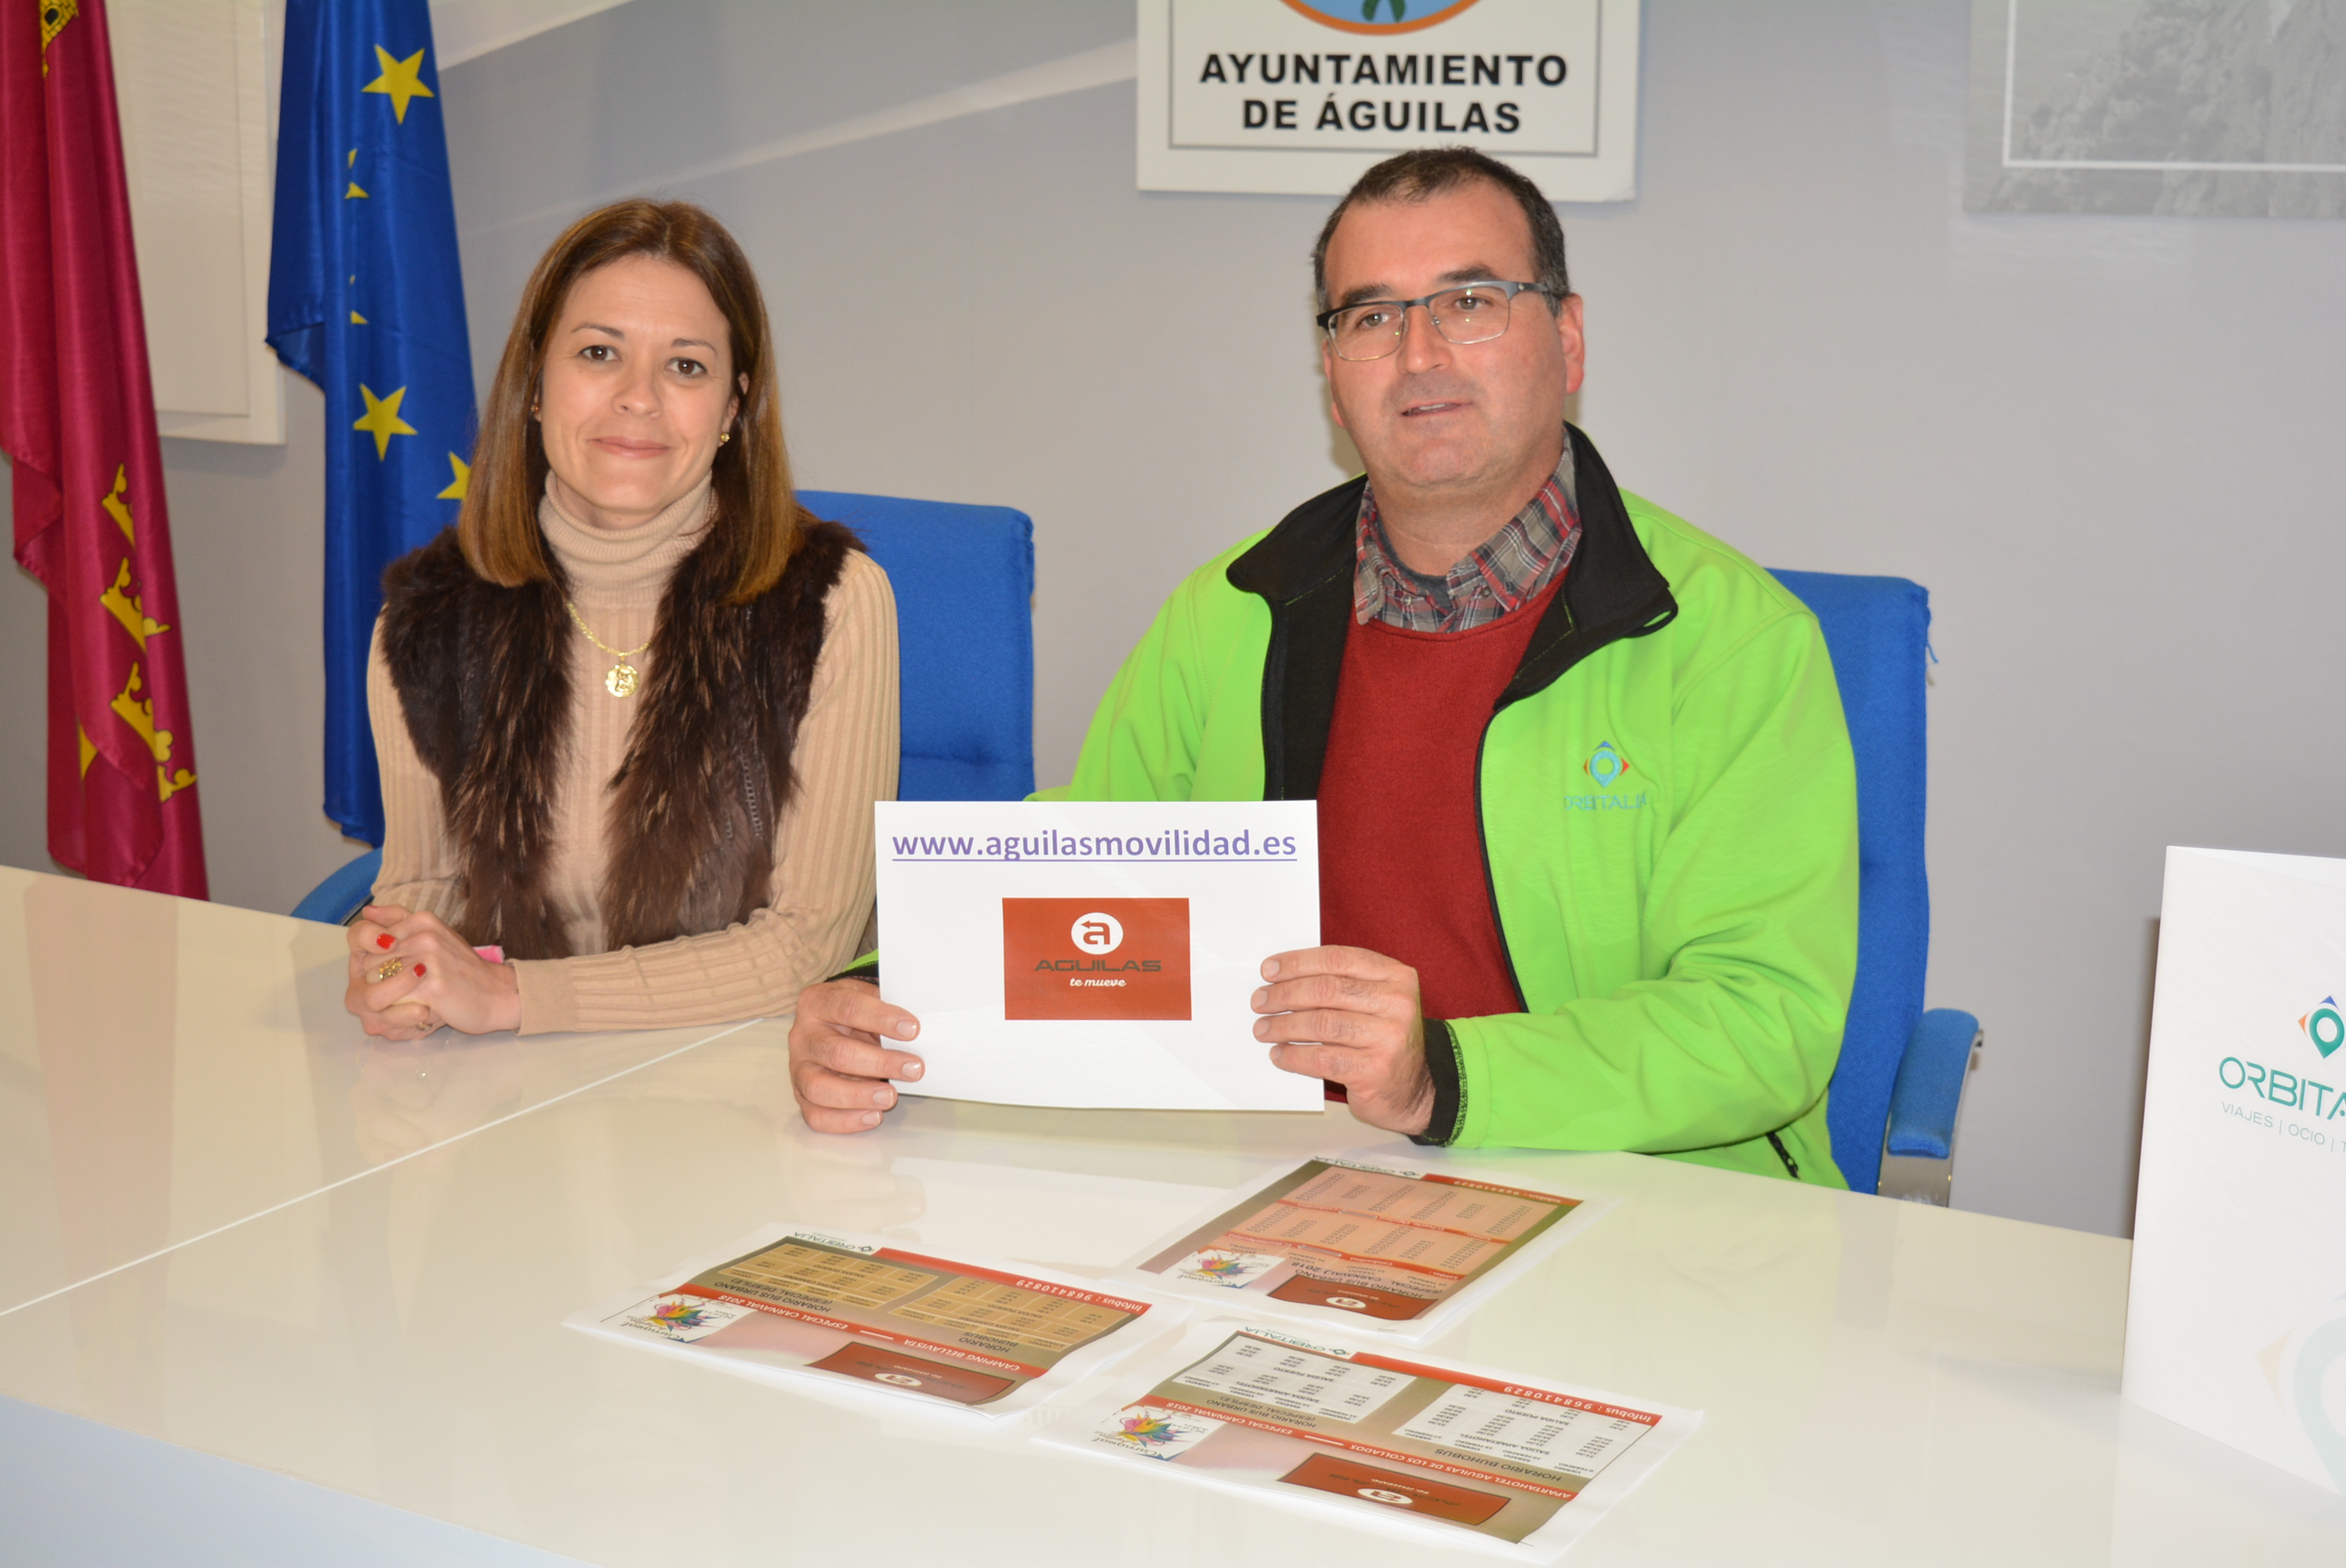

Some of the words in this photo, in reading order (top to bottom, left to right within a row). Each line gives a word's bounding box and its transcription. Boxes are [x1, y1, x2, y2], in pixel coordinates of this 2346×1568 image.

[1200, 53, 1568, 87] AYUNTAMIENTO
[1243, 100, 1298, 130] DE
[1316, 92, 1520, 133] ÁGUILAS
[892, 829, 1297, 862] www.aguilasmovilidad.es
[1034, 960, 1161, 972] AGUILAS
[1070, 977, 1084, 987] te
[1084, 978, 1127, 987] mueve
[2222, 1101, 2273, 1127] VIAJES
[2289, 1123, 2325, 1145] OCIO
[794, 1232, 855, 1249] ORBITALIA
[1291, 1262, 1321, 1272] 2018
[1295, 1269, 1342, 1283] URBANO
[1324, 1270, 1381, 1281] CARNAVAL)
[714, 1283, 758, 1295] URBANO
[731, 1279, 777, 1292] DESFILE)
[1016, 1280, 1092, 1301] 968410829
[1371, 1284, 1422, 1298] HORARIO
[1392, 1281, 1442, 1294] (ESPECIAL
[719, 1295, 745, 1304] 2018
[779, 1290, 833, 1304] (ESPECIAL
[746, 1301, 799, 1317] CARNAVAL
[783, 1298, 831, 1312] HORARIO
[1103, 1298, 1142, 1311] Infobus
[801, 1315, 848, 1329] ESPECIAL
[959, 1338, 1011, 1352] HORARIO
[964, 1332, 1019, 1347] BUHOBUS
[1245, 1327, 1325, 1351] ORBITALIA
[904, 1339, 965, 1357] BELLAVISTA
[966, 1355, 1019, 1370] CAMPING
[1273, 1367, 1305, 1376] PUERTO
[1237, 1381, 1289, 1396] APARTAHOTEL
[1220, 1396, 1262, 1410] DESFILE)
[1292, 1394, 1318, 1403] SALIDA
[1504, 1386, 1592, 1410] 968410829
[1167, 1403, 1192, 1411] 2018
[1207, 1400, 1247, 1412] URBANO
[1191, 1406, 1247, 1425] CARNAVAL
[1267, 1407, 1315, 1421] (ESPECIAL
[1505, 1410, 1538, 1419] PUERTO
[1541, 1417, 1568, 1425] SALIDA
[1607, 1408, 1651, 1422] Infobus
[1248, 1421, 1292, 1435] ESPECIAL
[1271, 1415, 1316, 1428] HORARIO
[1461, 1434, 1518, 1447] APARTAHOTEL
[1350, 1445, 1405, 1460] COLLADOS
[1520, 1446, 1549, 1455] SALIDA
[1435, 1449, 1498, 1467] BUHOBUS
[1445, 1467, 1492, 1480] AGUILAS
[1501, 1465, 1562, 1481] HORARIO
[1495, 1477, 1571, 1498] APARTAHOTEL
